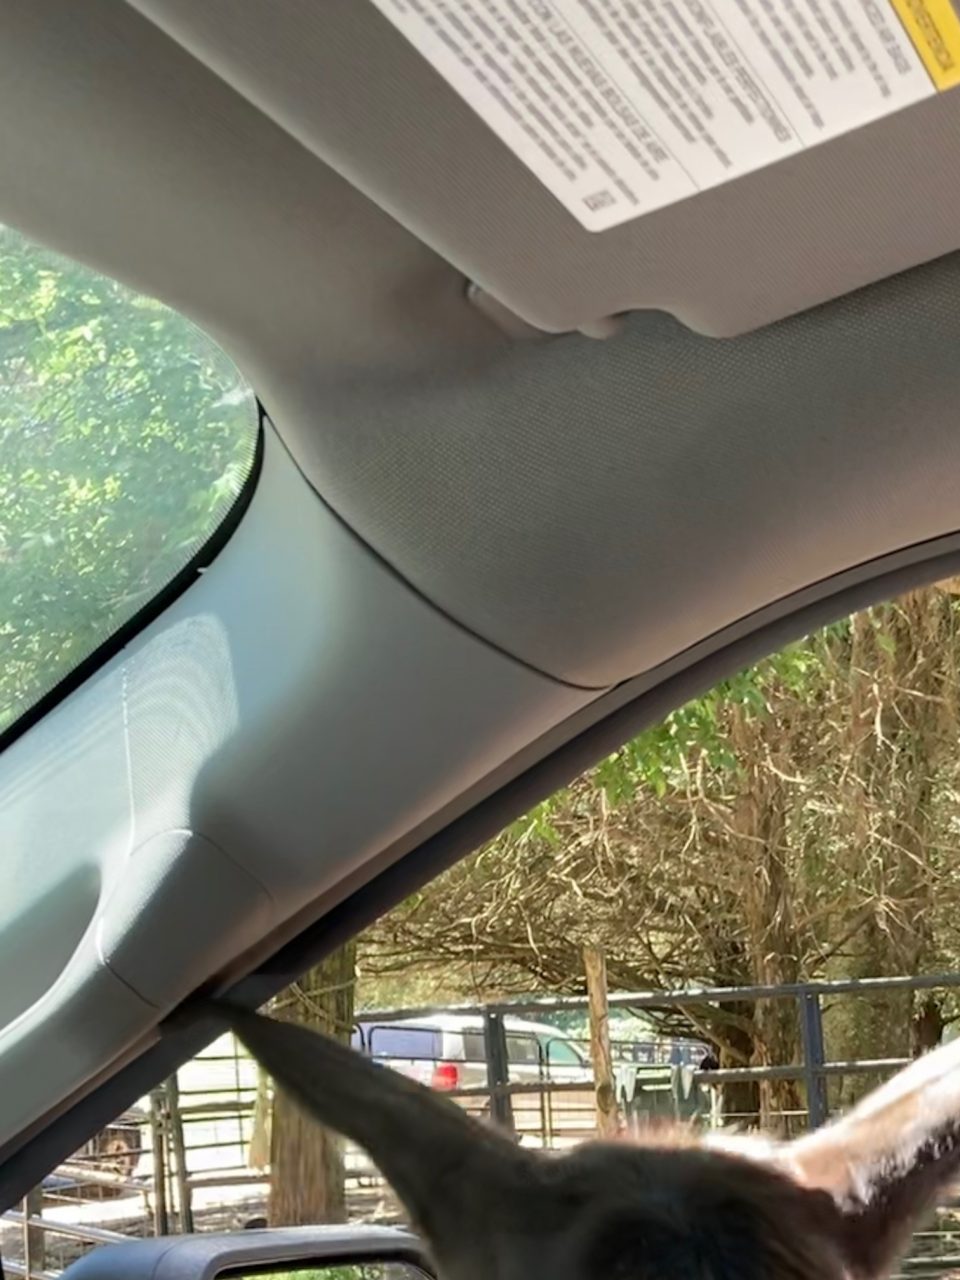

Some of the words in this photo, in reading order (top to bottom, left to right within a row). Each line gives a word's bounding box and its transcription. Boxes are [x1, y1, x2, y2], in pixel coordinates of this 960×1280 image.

[564, 45, 608, 87] NUEVAS
[598, 86, 640, 127] BOLSAS
[630, 125, 652, 142] DE
[642, 139, 671, 164] AIRE
